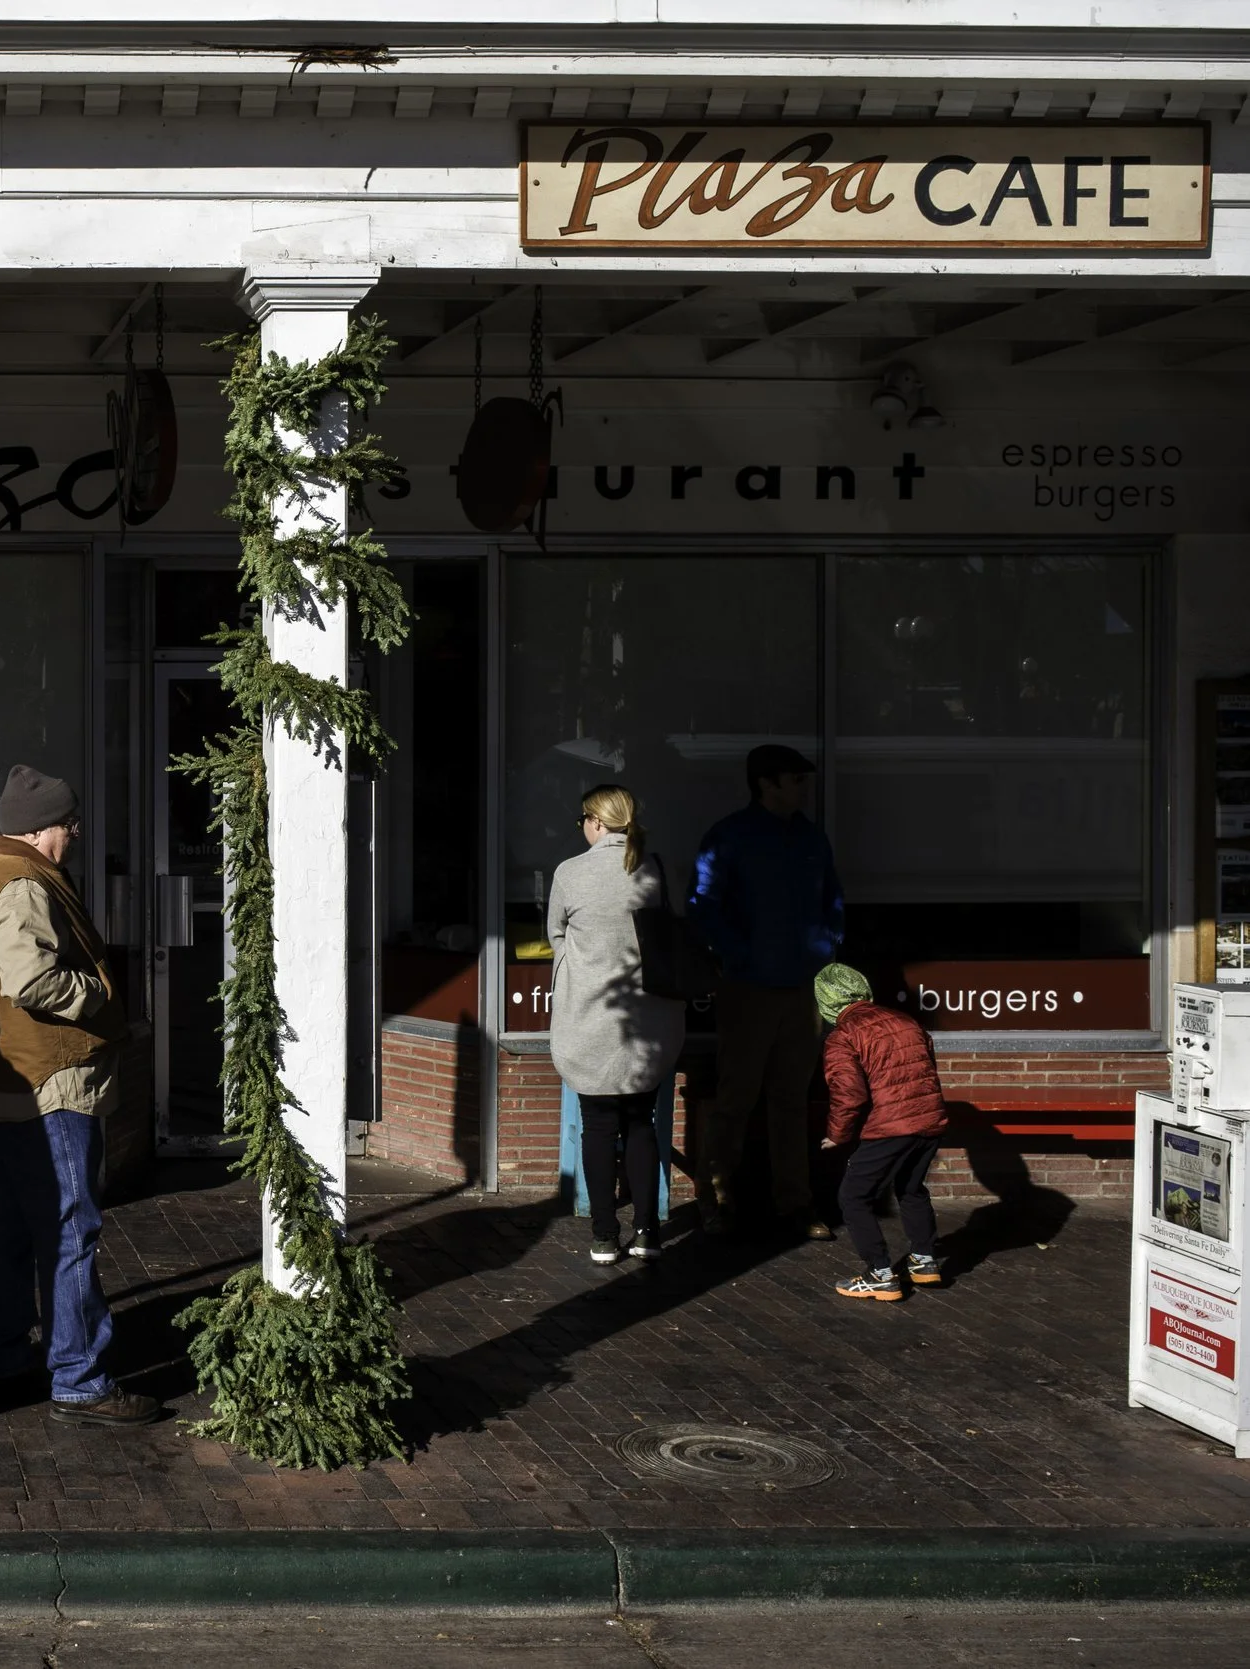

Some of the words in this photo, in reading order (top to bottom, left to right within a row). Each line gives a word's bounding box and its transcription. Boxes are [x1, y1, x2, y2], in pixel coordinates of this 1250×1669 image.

[560, 128, 896, 239] Plaza
[914, 155, 1151, 227] CAFE
[1003, 444, 1182, 476] espresso
[1035, 475, 1175, 521] burgers
[178, 842, 223, 856] Restro
[919, 984, 1058, 1018] burgers
[1181, 1018, 1211, 1032] JOURNAL
[1184, 1234, 1200, 1248] Santa
[1201, 1241, 1209, 1251] Fe
[1152, 1280, 1202, 1306] ALBUQUERQUE
[1202, 1300, 1235, 1320] JOURNAL
[1163, 1317, 1221, 1348] ABQJournal.com
[1168, 1335, 1184, 1350] (505)
[1185, 1343, 1215, 1363] 823-4400
